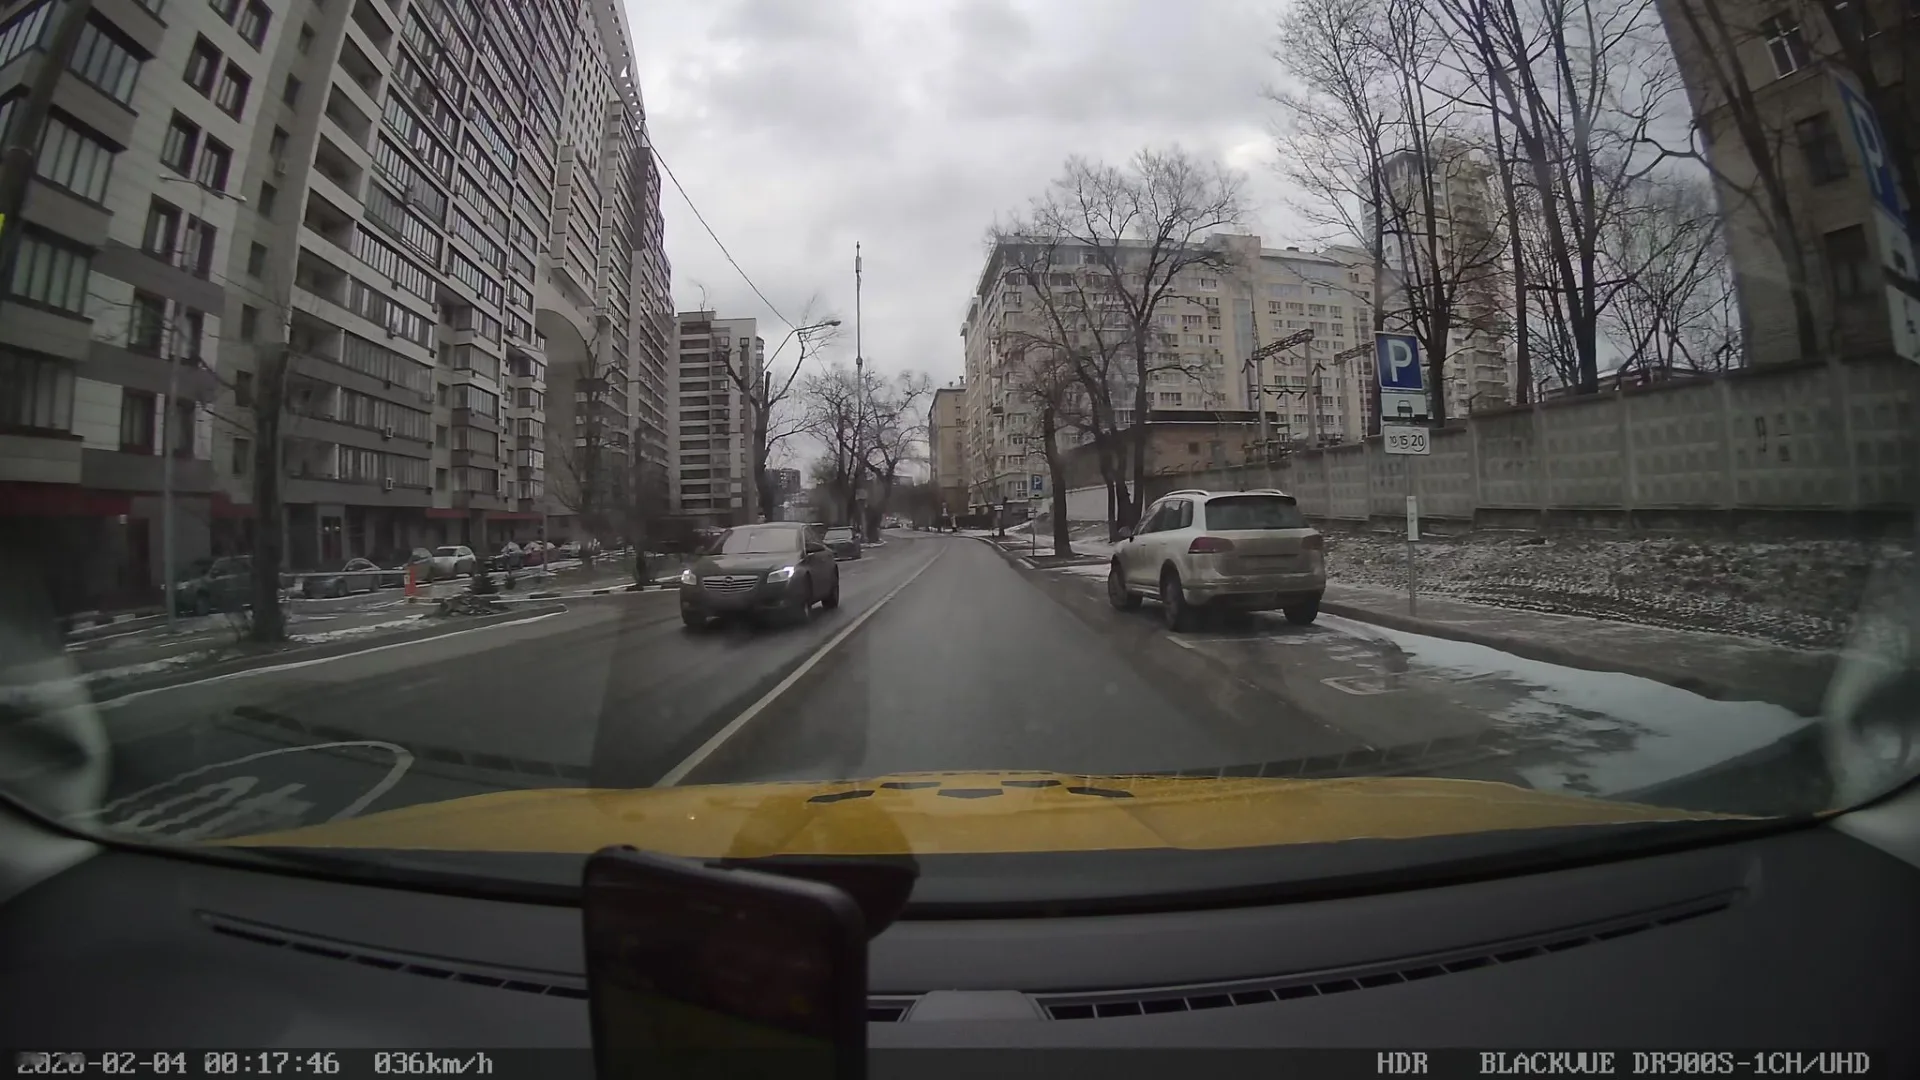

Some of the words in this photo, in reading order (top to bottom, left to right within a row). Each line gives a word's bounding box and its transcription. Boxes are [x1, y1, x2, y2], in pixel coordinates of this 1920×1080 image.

[1387, 339, 1412, 382] P
[1399, 435, 1408, 446] 15
[1411, 434, 1424, 447] 20
[1034, 476, 1041, 489] P
